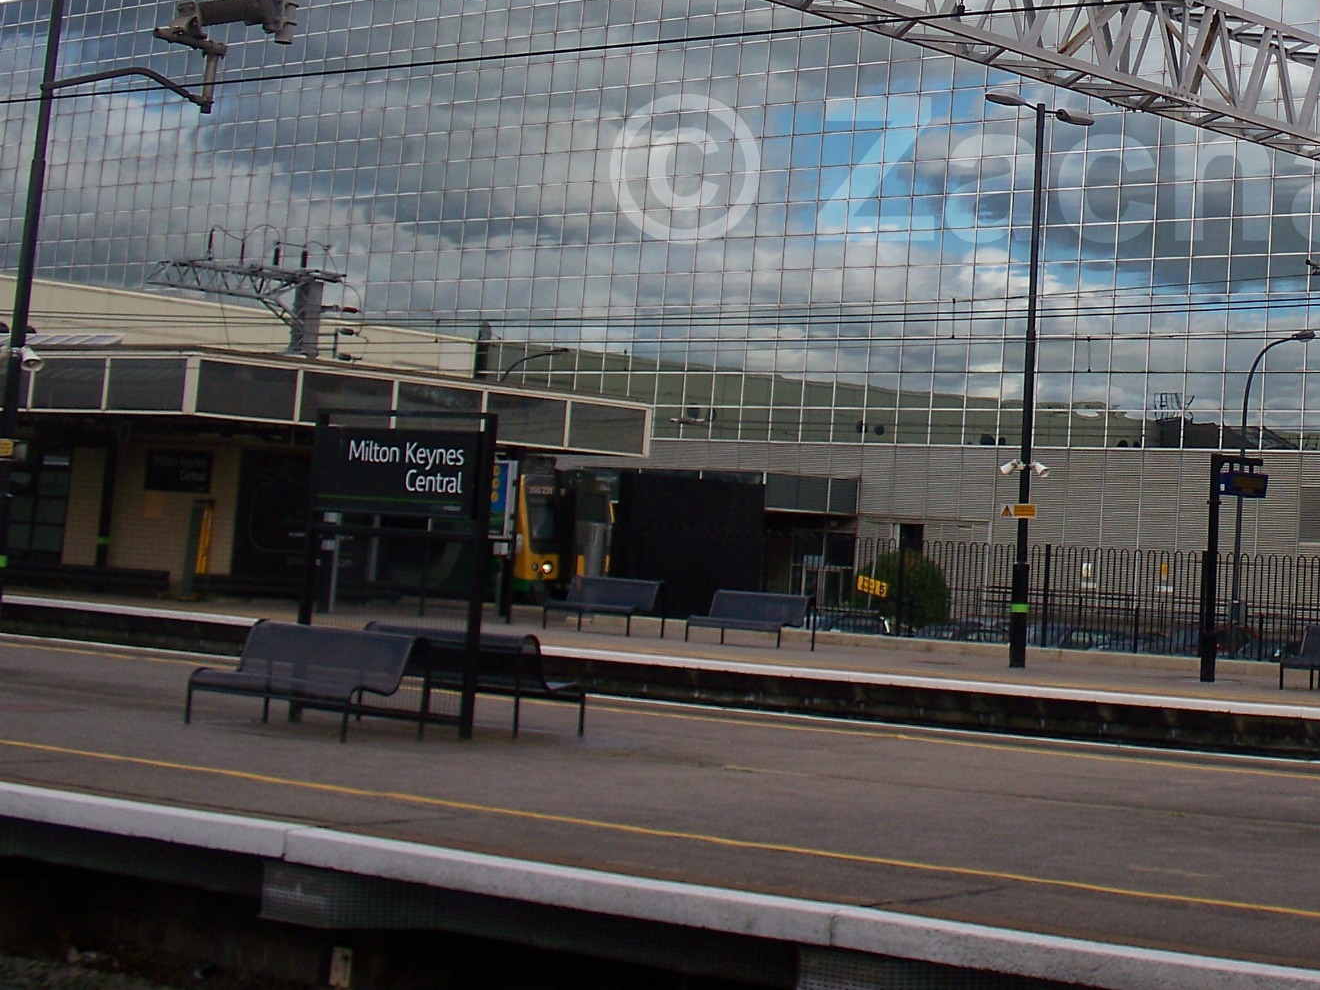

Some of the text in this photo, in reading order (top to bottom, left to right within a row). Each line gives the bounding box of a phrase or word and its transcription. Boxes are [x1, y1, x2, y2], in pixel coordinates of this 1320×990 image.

[349, 440, 464, 470] Milton Keynes
[405, 469, 462, 494] Central
